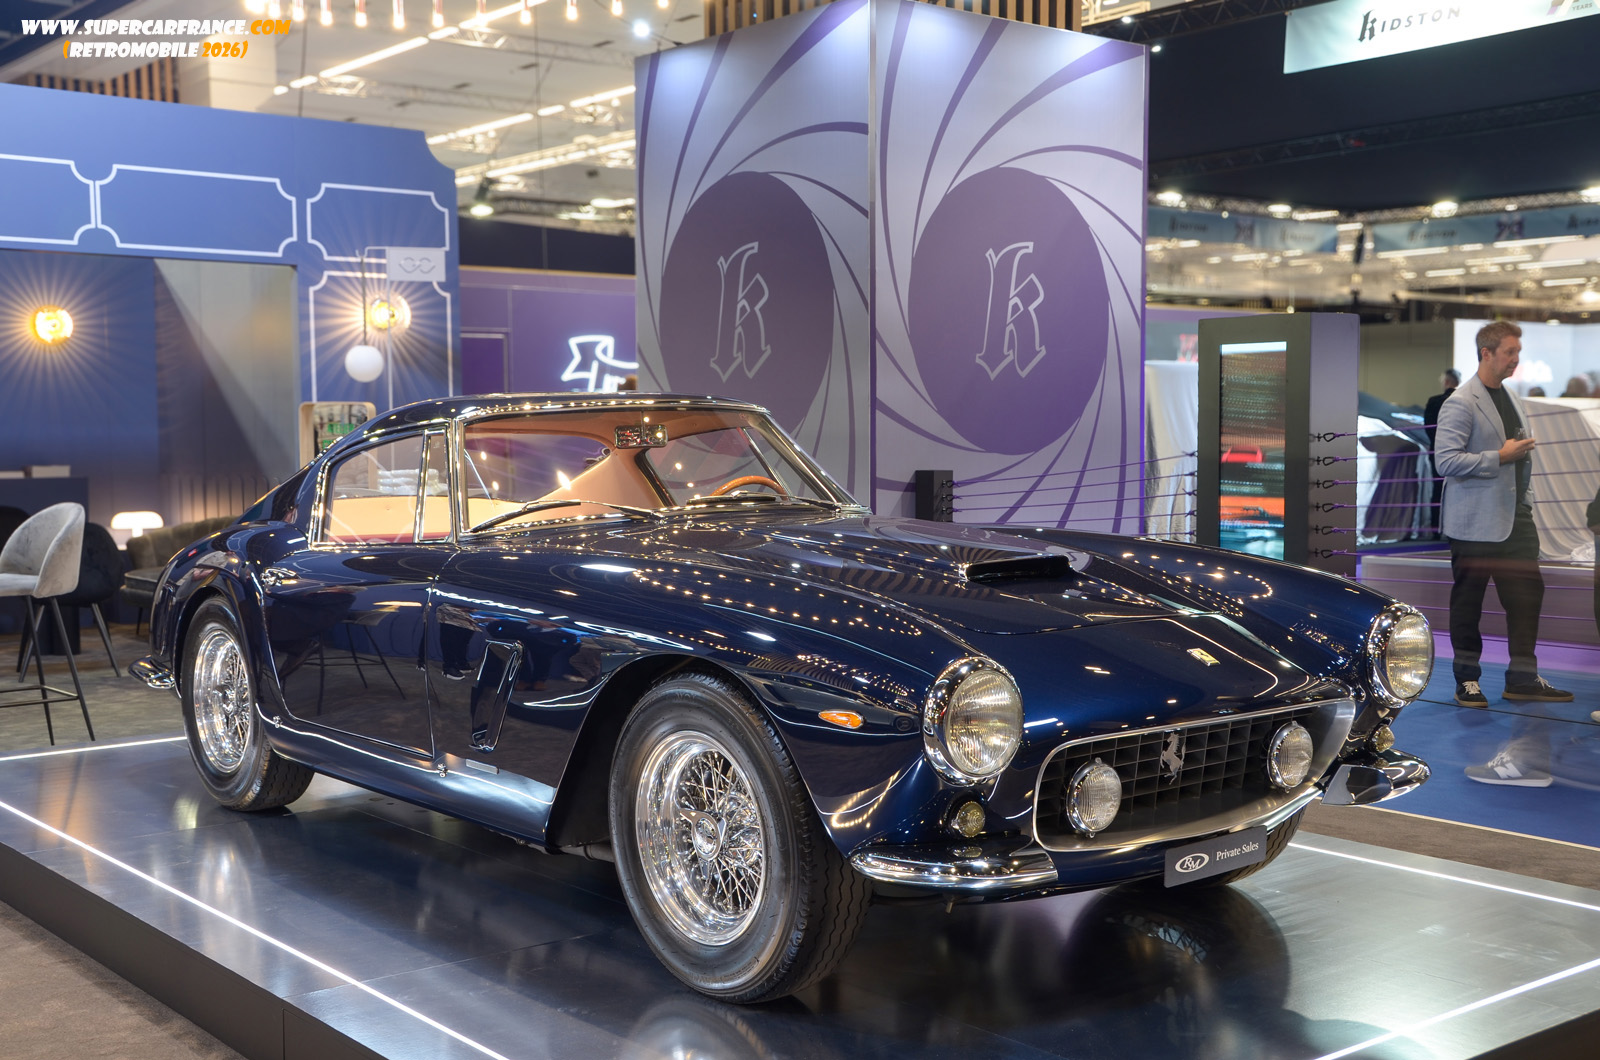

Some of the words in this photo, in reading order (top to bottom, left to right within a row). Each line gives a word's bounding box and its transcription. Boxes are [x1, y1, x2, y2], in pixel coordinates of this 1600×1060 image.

[1572, 3, 1592, 11] YEARS
[1358, 7, 1460, 42] KIDSTON
[1183, 857, 1201, 870] RM
[1216, 848, 1241, 861] Private
[1242, 841, 1259, 854] Sales
